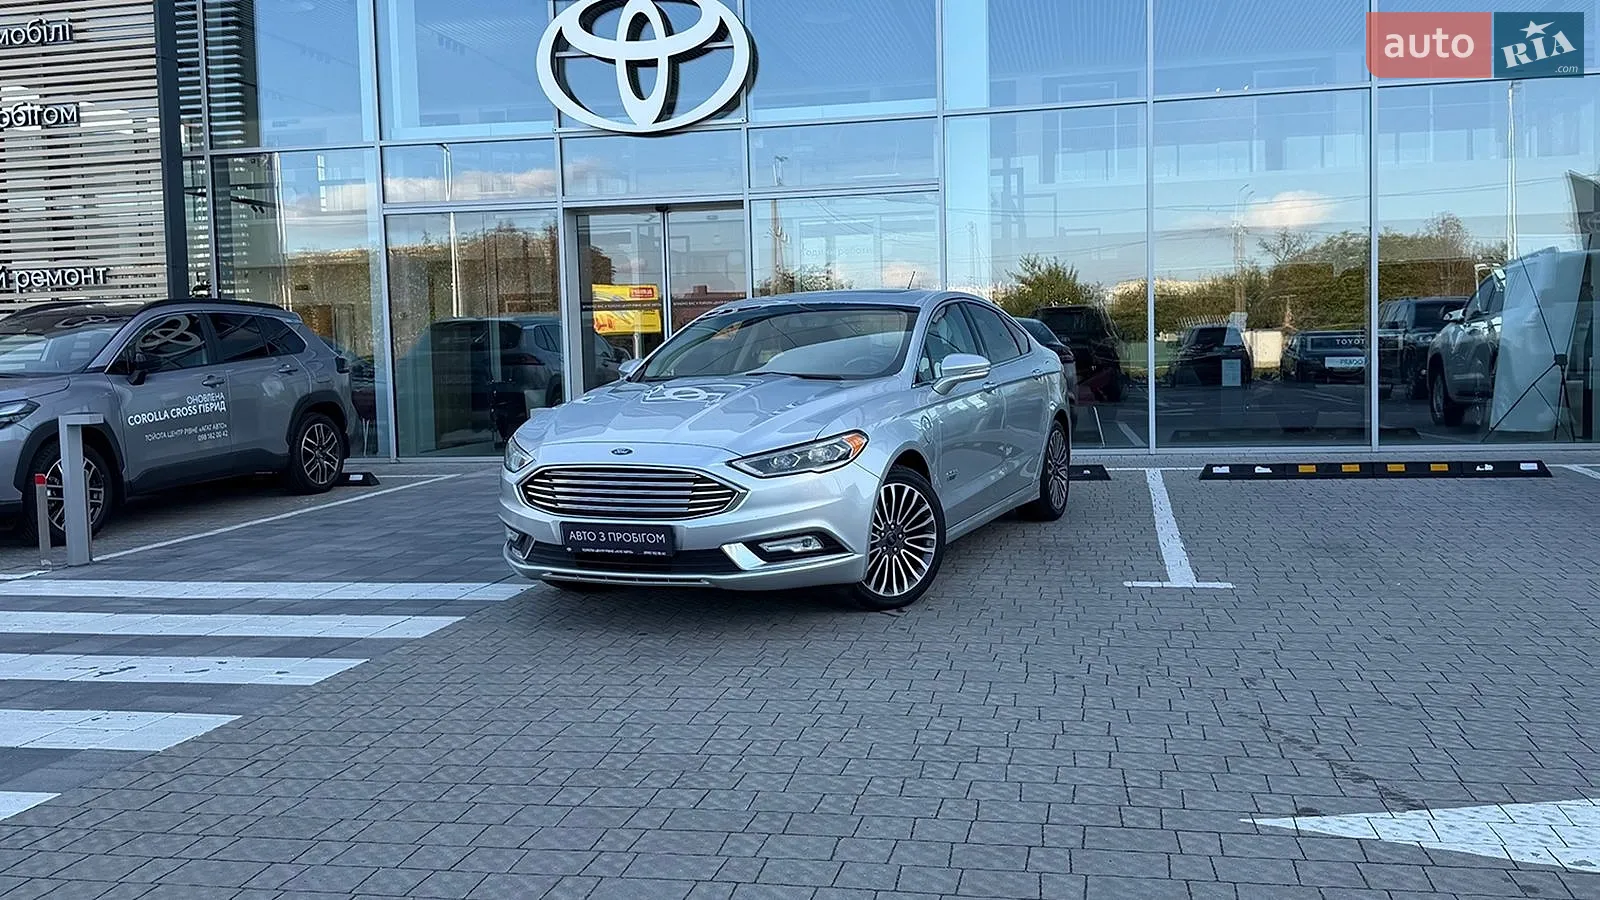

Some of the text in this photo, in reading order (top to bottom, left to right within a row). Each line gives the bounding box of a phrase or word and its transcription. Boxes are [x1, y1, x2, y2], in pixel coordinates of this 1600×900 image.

[14, 267, 107, 293] ремонт
[186, 392, 225, 405] ОНОВЛЕНА
[127, 401, 226, 426] COROLLA CROSS ГІБРИД
[569, 531, 597, 541] АВТО
[608, 532, 666, 544] ПРОБІГОМ
